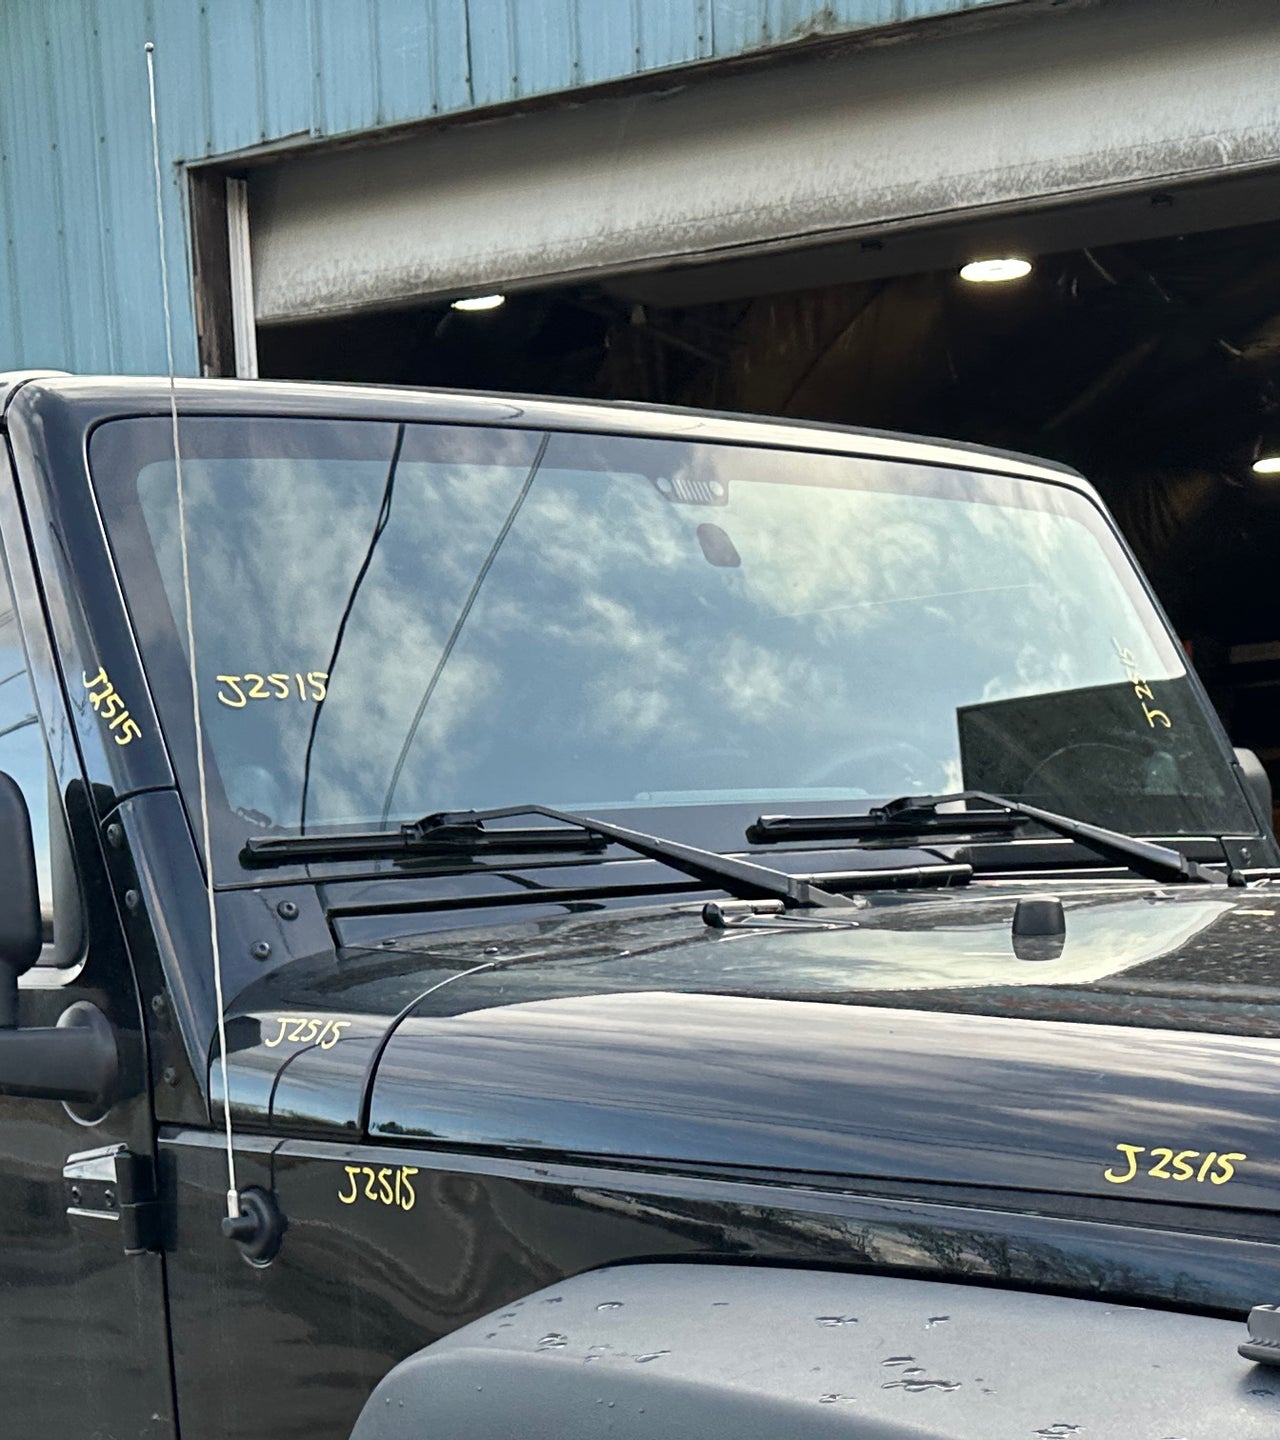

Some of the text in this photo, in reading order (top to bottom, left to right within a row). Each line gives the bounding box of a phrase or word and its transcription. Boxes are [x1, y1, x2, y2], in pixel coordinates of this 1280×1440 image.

[82, 667, 143, 746] J2515
[217, 672, 329, 708] J2515
[266, 1017, 352, 1050] J2515
[1104, 1143, 1248, 1185] J2515
[339, 1165, 419, 1210] J2515
